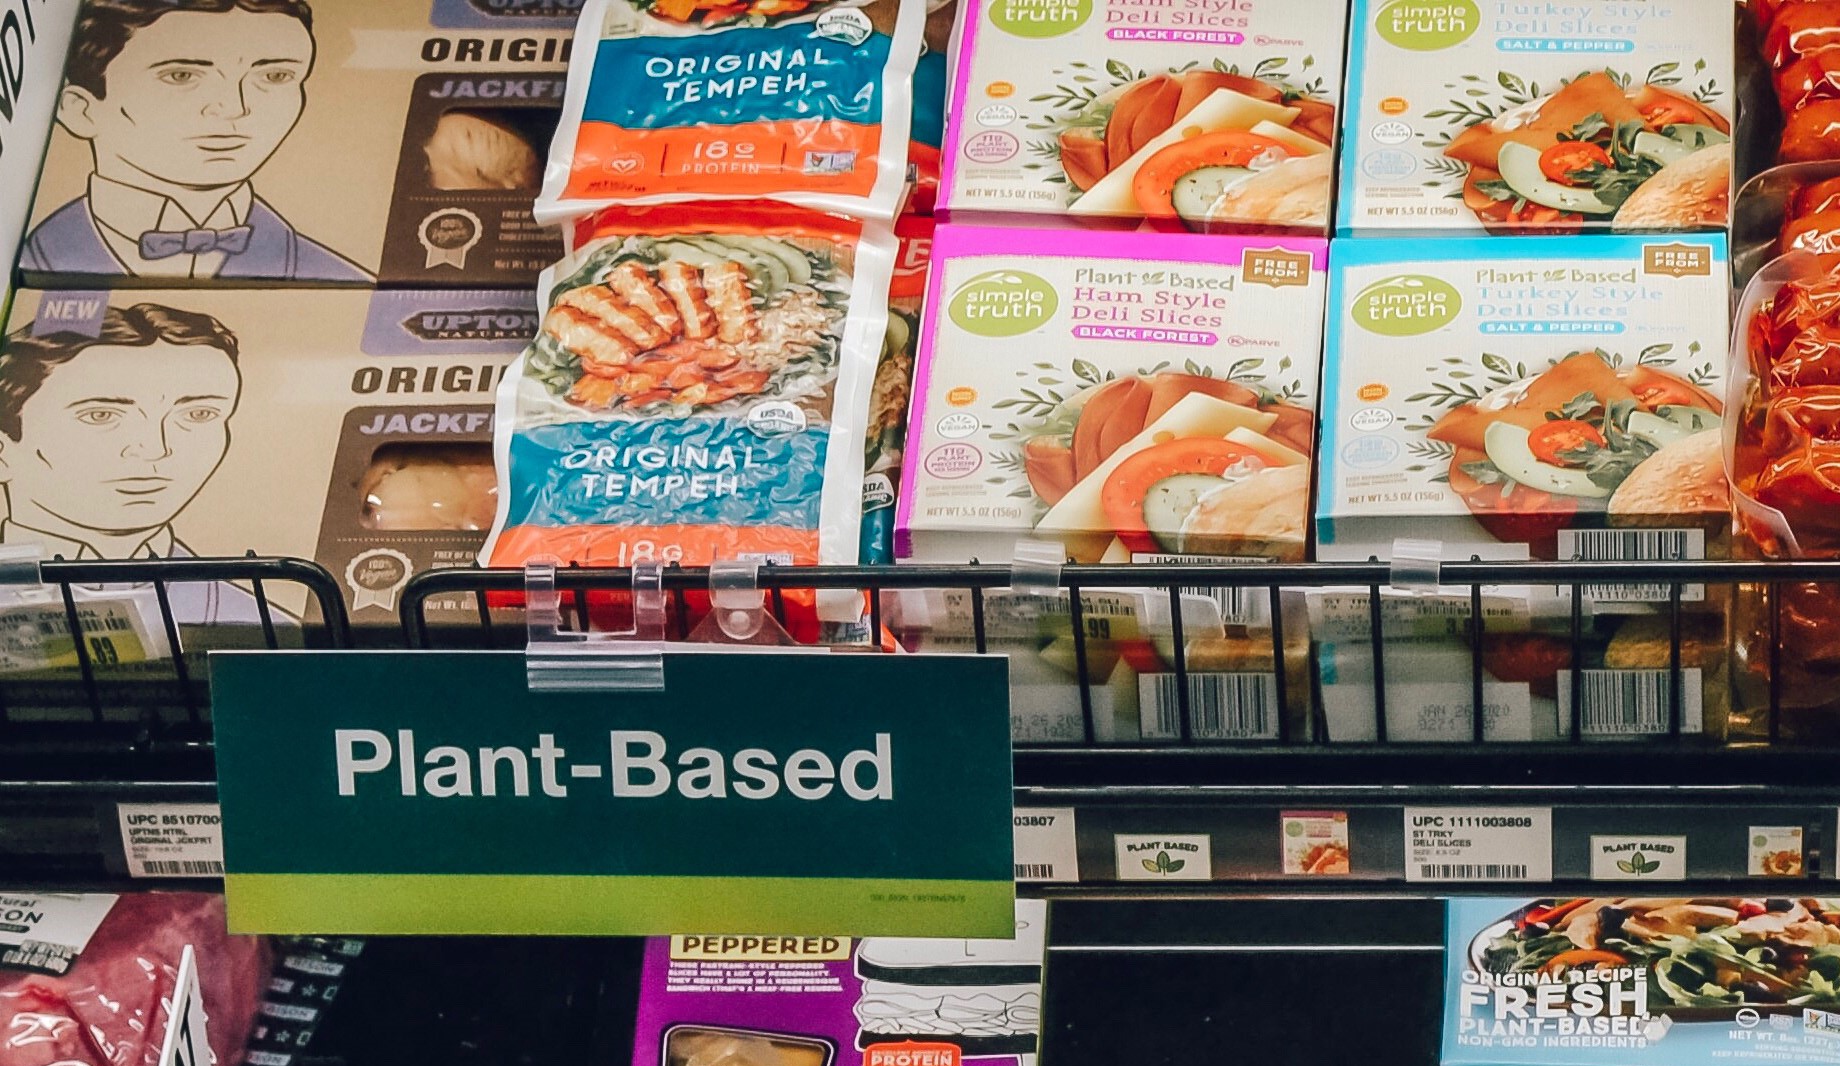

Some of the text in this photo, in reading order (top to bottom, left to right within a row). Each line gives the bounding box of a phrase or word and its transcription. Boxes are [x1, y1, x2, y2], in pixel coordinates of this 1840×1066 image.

[1005, 7, 1078, 23] truth
[1106, 10, 1249, 28] Deli Slices
[645, 48, 829, 77] ORIGINAL
[663, 73, 807, 101] TEMPEH
[1254, 258, 1298, 269] FREE
[1075, 268, 1235, 291] Plant Based
[1253, 268, 1298, 278] FROM
[1476, 269, 1638, 284] Plant Based
[966, 289, 1044, 305] simple
[1074, 287, 1227, 310] Ham Style
[1369, 291, 1447, 306] simple
[1478, 287, 1663, 302] Turkey Style
[45, 300, 100, 322] NEW
[966, 302, 1043, 319] truth
[1071, 306, 1223, 328] Deli Slices
[1368, 303, 1446, 320] truth
[1477, 303, 1628, 317] Deli Slices
[1079, 327, 1210, 343] BLACK FOREST
[1486, 322, 1615, 333] SALT & PEPPER
[351, 366, 508, 393] ORIGI
[360, 413, 494, 435] JACKF
[564, 446, 760, 470] ORIGINAL
[582, 474, 738, 498] TEMPEH
[927, 507, 945, 517] NET
[946, 507, 960, 517] WT
[962, 507, 976, 517] 5.5
[978, 507, 990, 517] OZ
[334, 728, 895, 801] Plant-Based
[127, 815, 220, 825] UPC 8510700
[1412, 816, 1532, 827] UPC 1111003808
[1127, 842, 1160, 851] PLANT
[1603, 844, 1675, 853] PLANT BASED
[682, 936, 840, 954] PEPPERED
